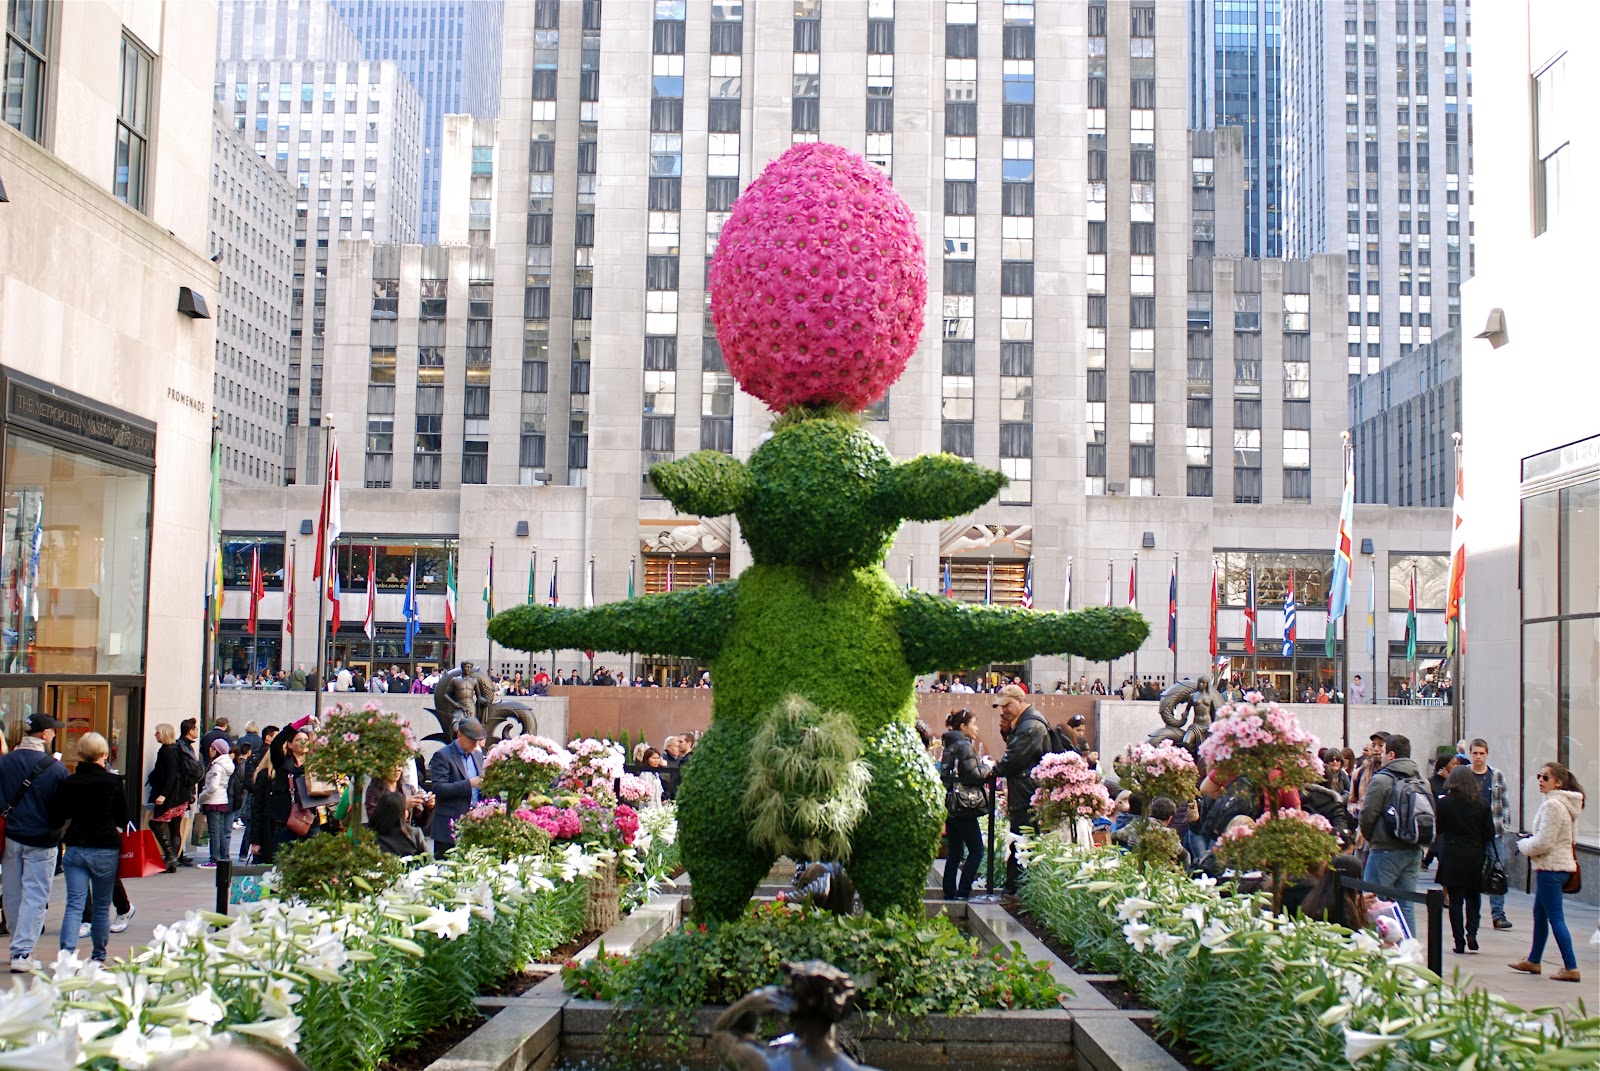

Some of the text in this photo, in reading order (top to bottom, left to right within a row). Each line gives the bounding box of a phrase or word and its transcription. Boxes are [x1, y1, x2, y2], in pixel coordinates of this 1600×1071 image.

[167, 386, 205, 413] PROMENADE
[17, 394, 33, 412] THE
[34, 401, 86, 429] METROPOLITAN
[87, 419, 114, 439] MUSEUM
[135, 435, 150, 450] SHOP
